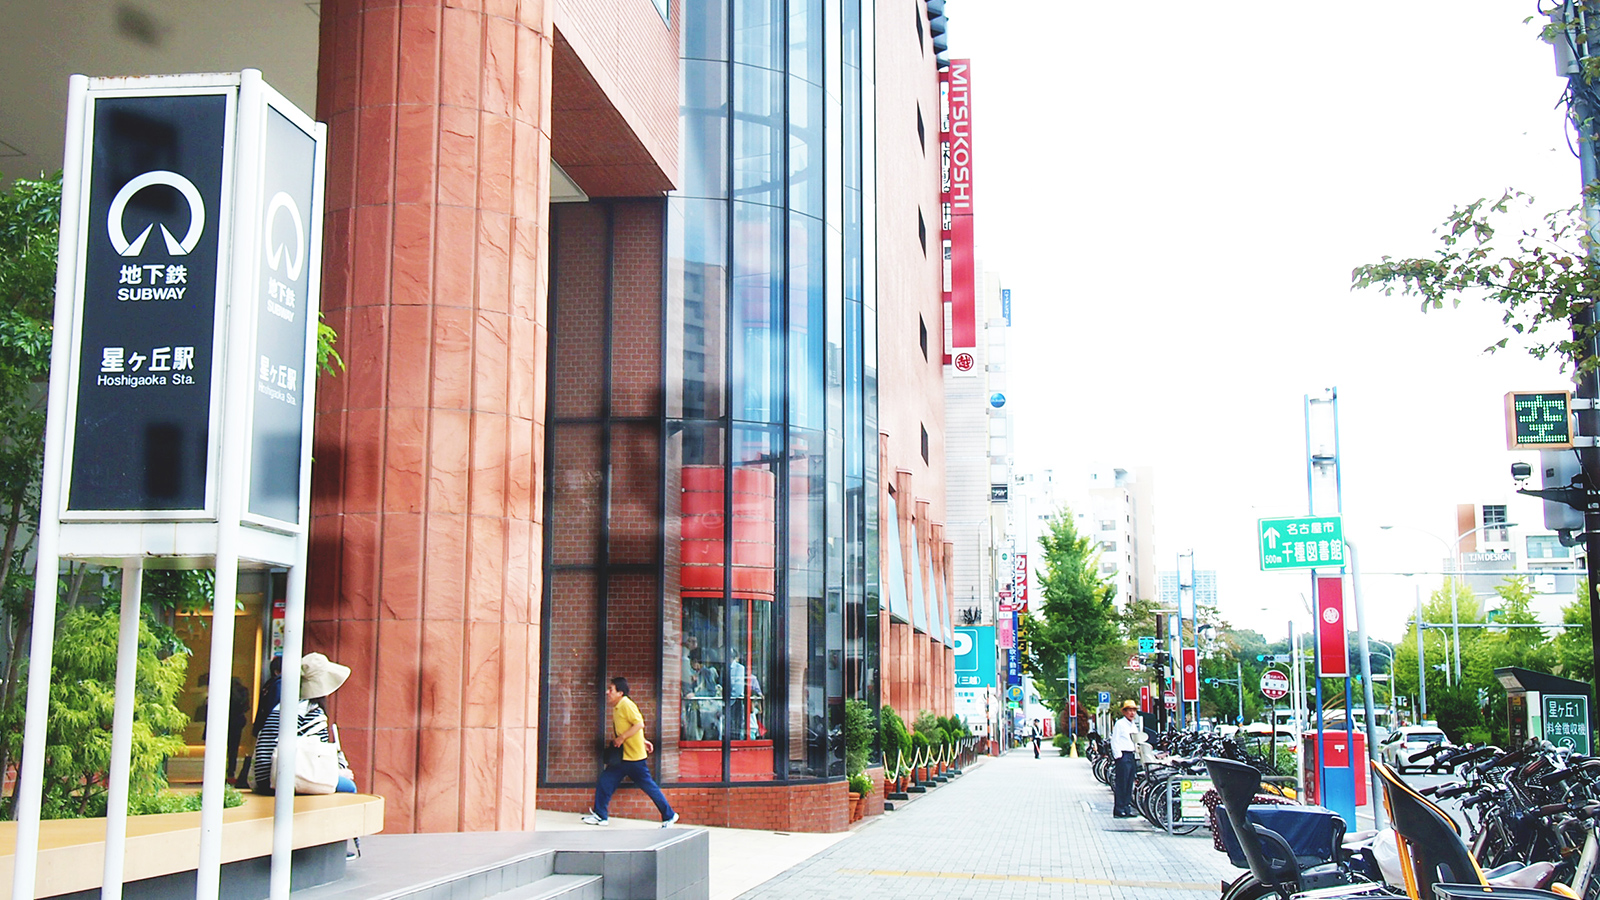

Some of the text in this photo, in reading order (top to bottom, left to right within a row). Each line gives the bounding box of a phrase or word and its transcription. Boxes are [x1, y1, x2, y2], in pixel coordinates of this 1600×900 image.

[951, 63, 970, 208] MITSUKOSHI
[119, 264, 187, 285] 地下鉄
[117, 287, 187, 301] SUBWAY
[268, 276, 296, 308] 地下鉄
[97, 373, 195, 387] Hoshigaoka Sta.
[1515, 394, 1565, 442] 空
[1286, 522, 1335, 535] 名古屋市
[1265, 554, 1283, 564] 500m
[1281, 539, 1343, 563] 千種図書館
[1016, 556, 1027, 611] カラオケ
[1182, 780, 1192, 792] P
